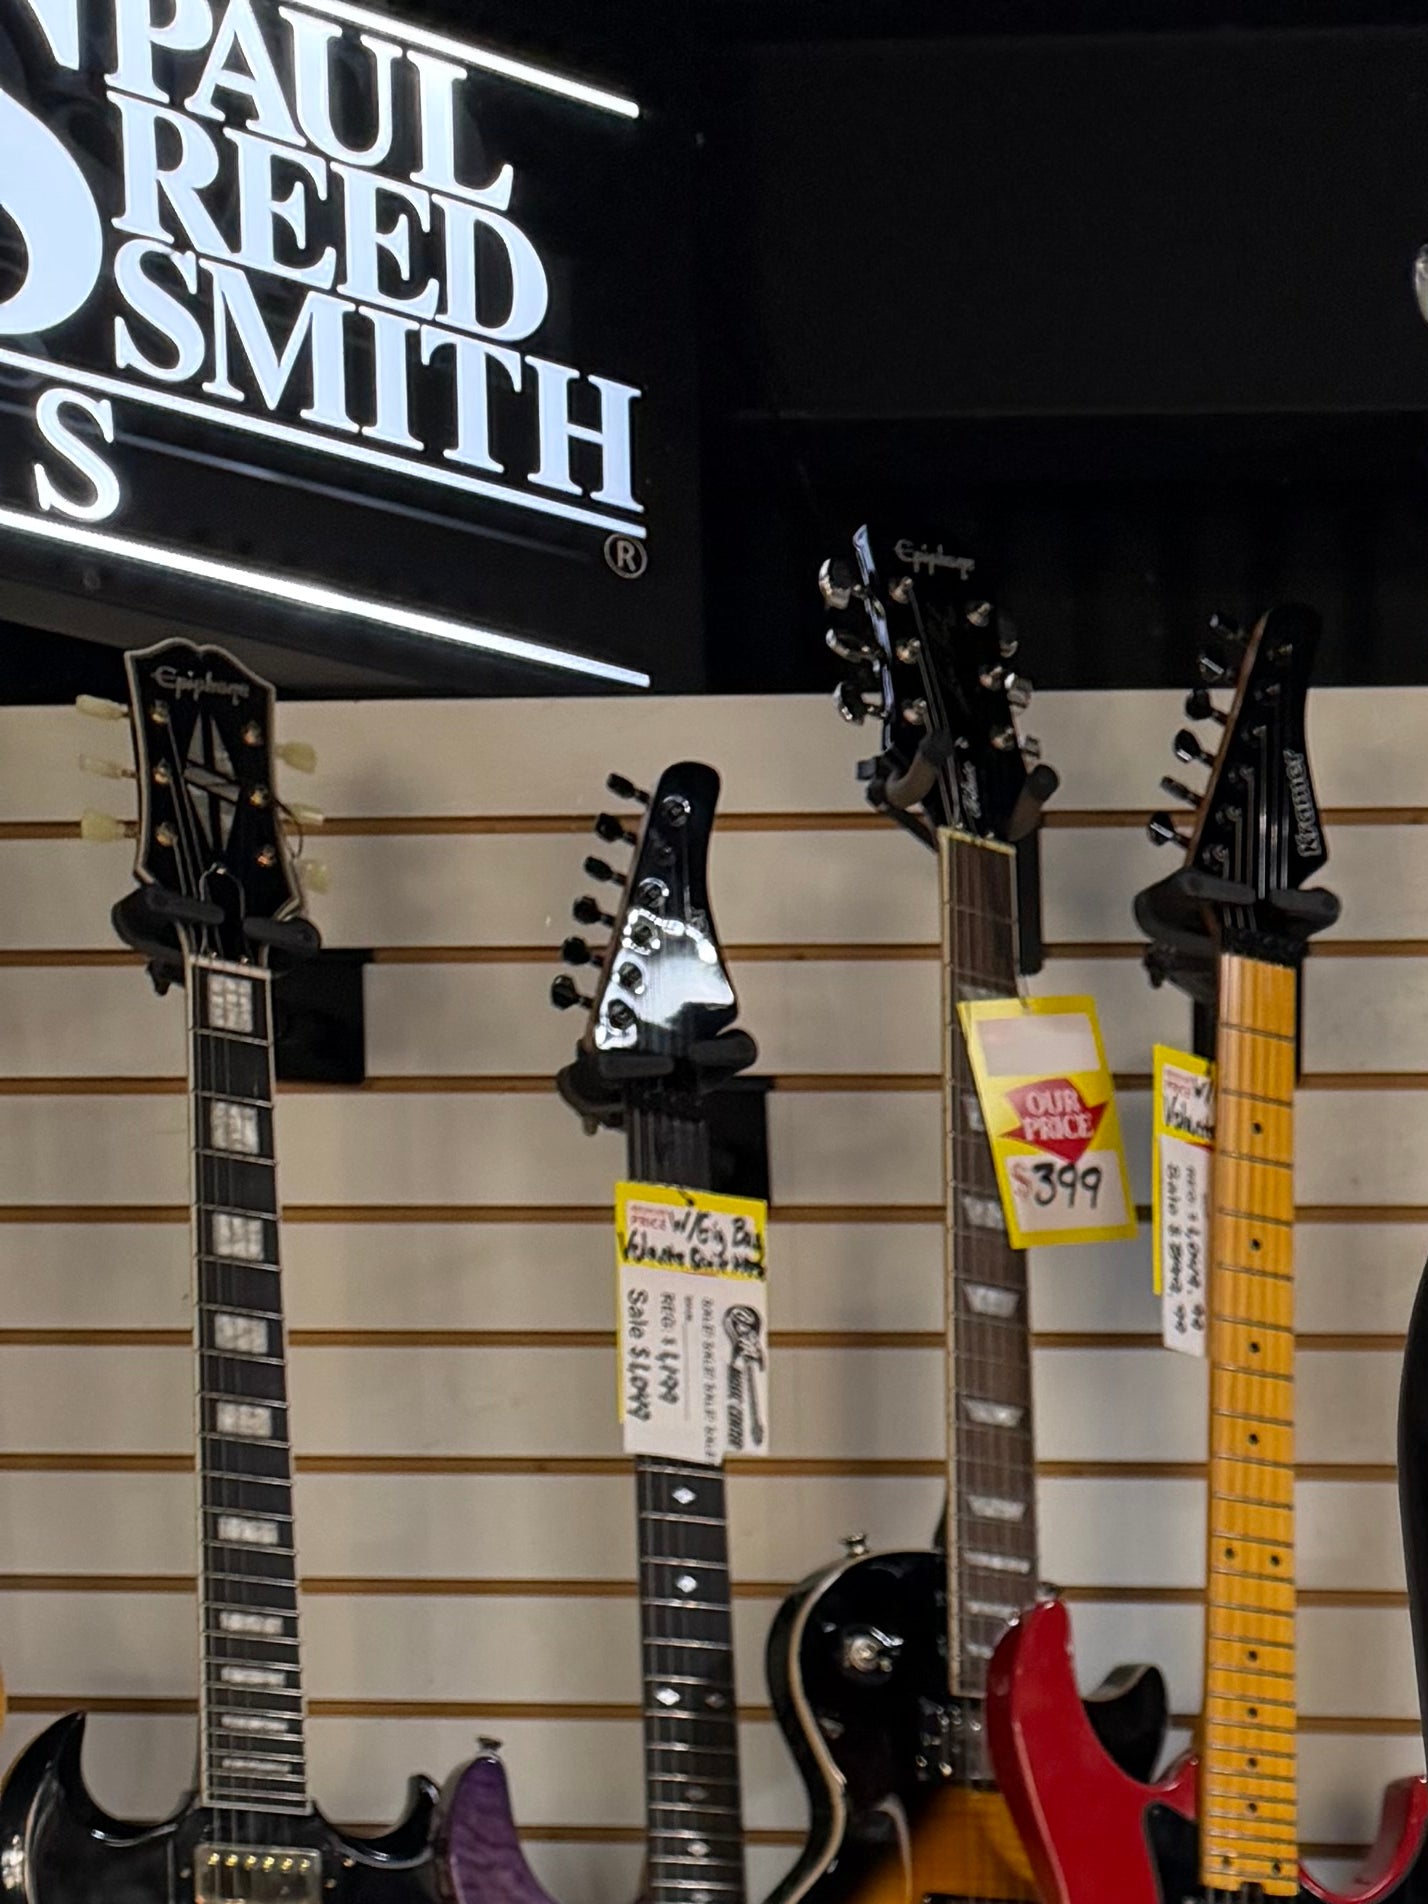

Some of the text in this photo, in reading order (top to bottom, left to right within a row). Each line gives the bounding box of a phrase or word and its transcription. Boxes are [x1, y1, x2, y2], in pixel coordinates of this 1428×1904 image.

[104, 0, 515, 212] PAUL
[105, 90, 549, 344] REED
[112, 238, 645, 514] SMITH
[1024, 1087, 1082, 1116] OUR
[1023, 1113, 1095, 1143] PRICE
[1009, 1161, 1103, 1209] $399
[627, 1288, 650, 1340] Sale
